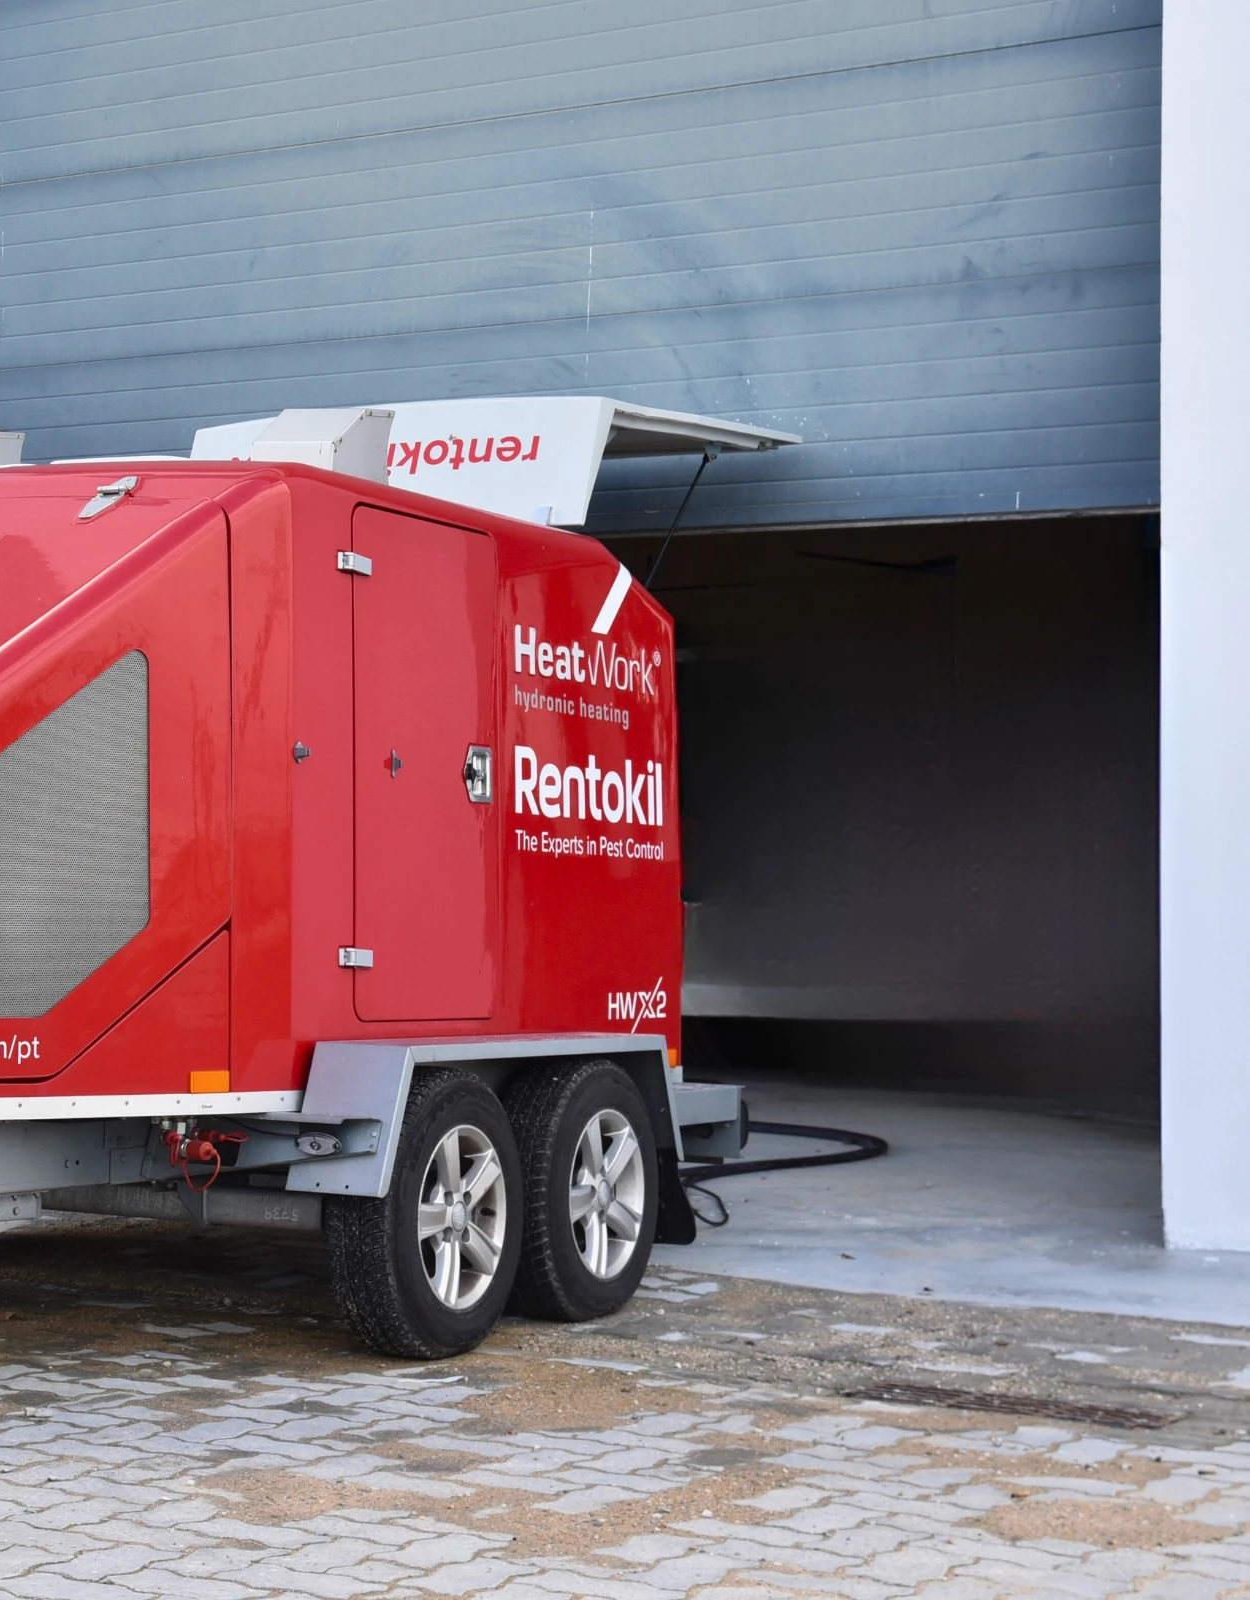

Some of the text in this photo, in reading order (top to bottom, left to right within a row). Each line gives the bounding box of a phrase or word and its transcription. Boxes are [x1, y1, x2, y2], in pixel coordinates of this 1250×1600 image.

[386, 435, 541, 476] rentoki
[514, 684, 630, 730] hydronic heating
[514, 745, 663, 827] Rentokil
[515, 829, 664, 860] The Experts in Pest Control
[608, 976, 667, 1034] HWX2
